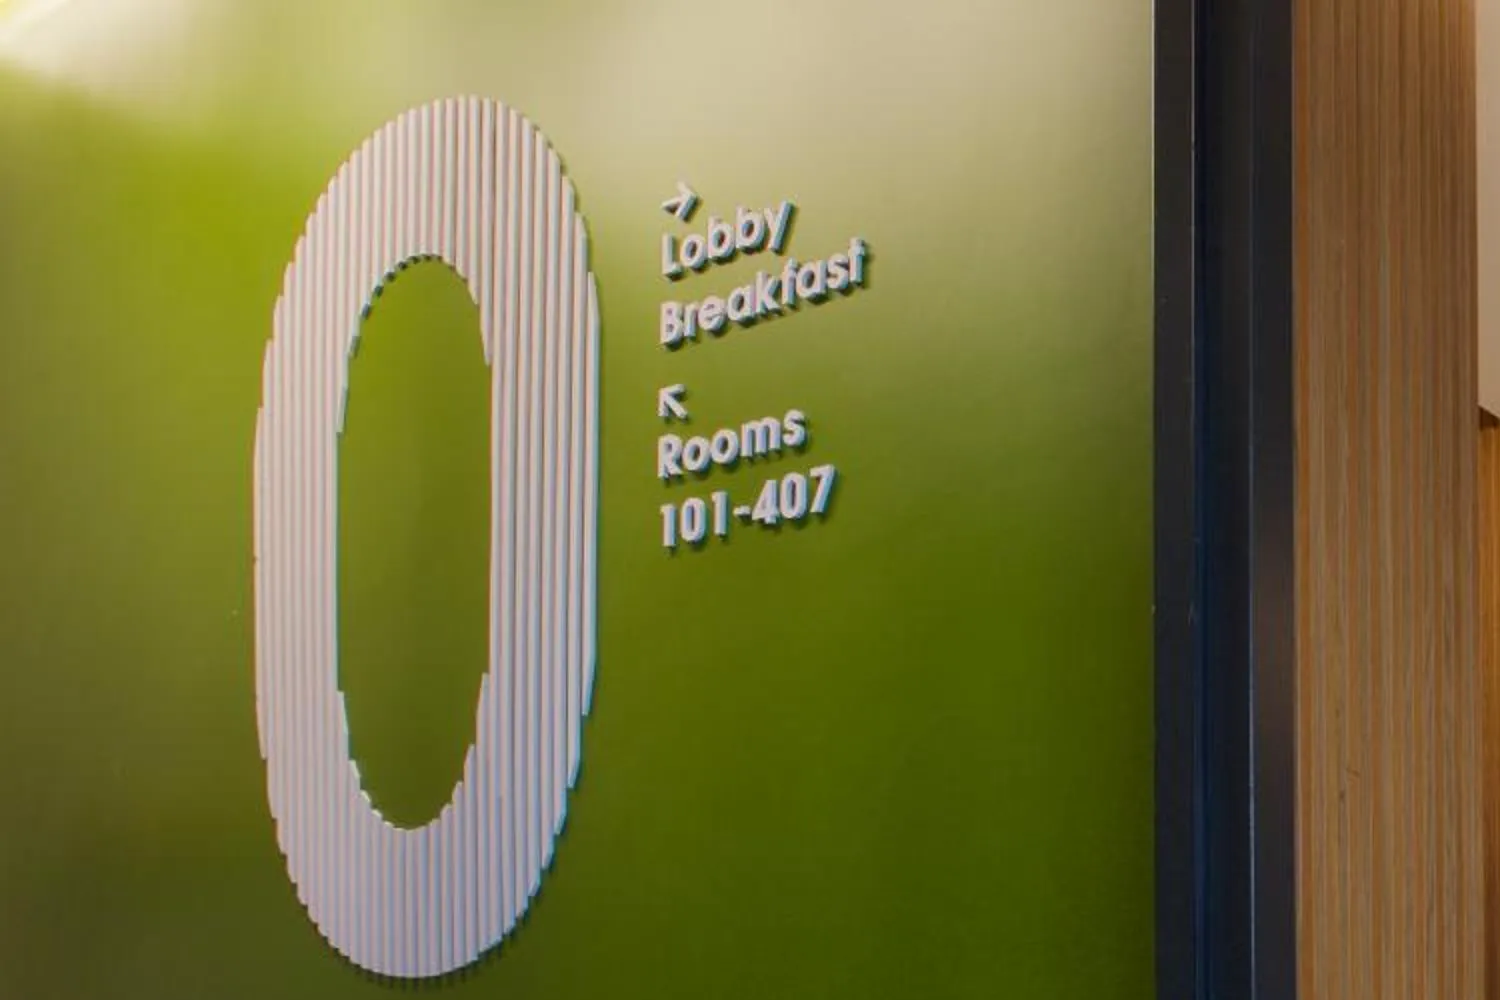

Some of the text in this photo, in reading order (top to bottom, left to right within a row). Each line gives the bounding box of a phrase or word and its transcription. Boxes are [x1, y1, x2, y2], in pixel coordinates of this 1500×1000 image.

[660, 201, 795, 277] Lobby
[660, 238, 866, 345] Breakfast
[658, 409, 806, 479] Rooms
[253, 95, 600, 979] 0
[661, 464, 836, 548] 101-407
